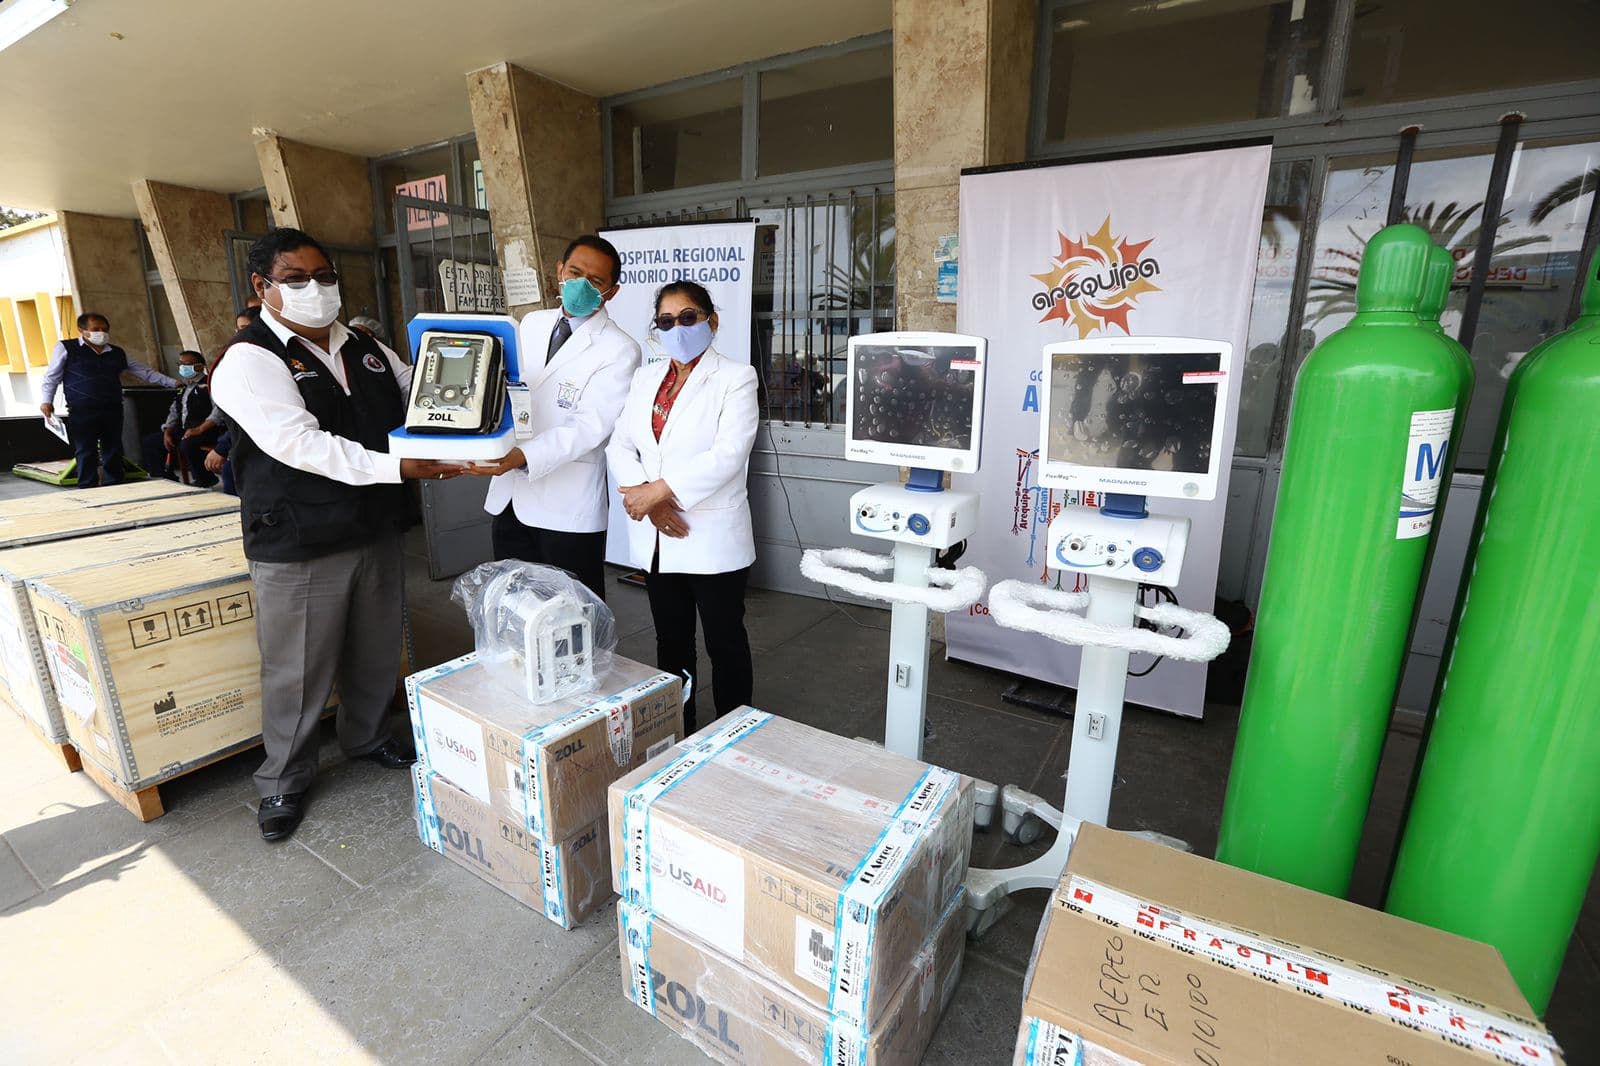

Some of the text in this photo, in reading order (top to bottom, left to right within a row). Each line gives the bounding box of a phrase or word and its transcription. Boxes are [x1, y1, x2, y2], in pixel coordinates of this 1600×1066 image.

[397, 180, 447, 225] ALIDA
[620, 246, 746, 266] OSPITAL REGIONAL
[619, 266, 741, 286] ONORIO DELGADO
[427, 412, 456, 423] ZOLL
[1098, 477, 1148, 487] MAGNAMED
[1019, 487, 1030, 529] Arequipa
[445, 735, 477, 762] USAID
[668, 862, 728, 905] USAID
[1158, 920, 1300, 974] FRAGIL
